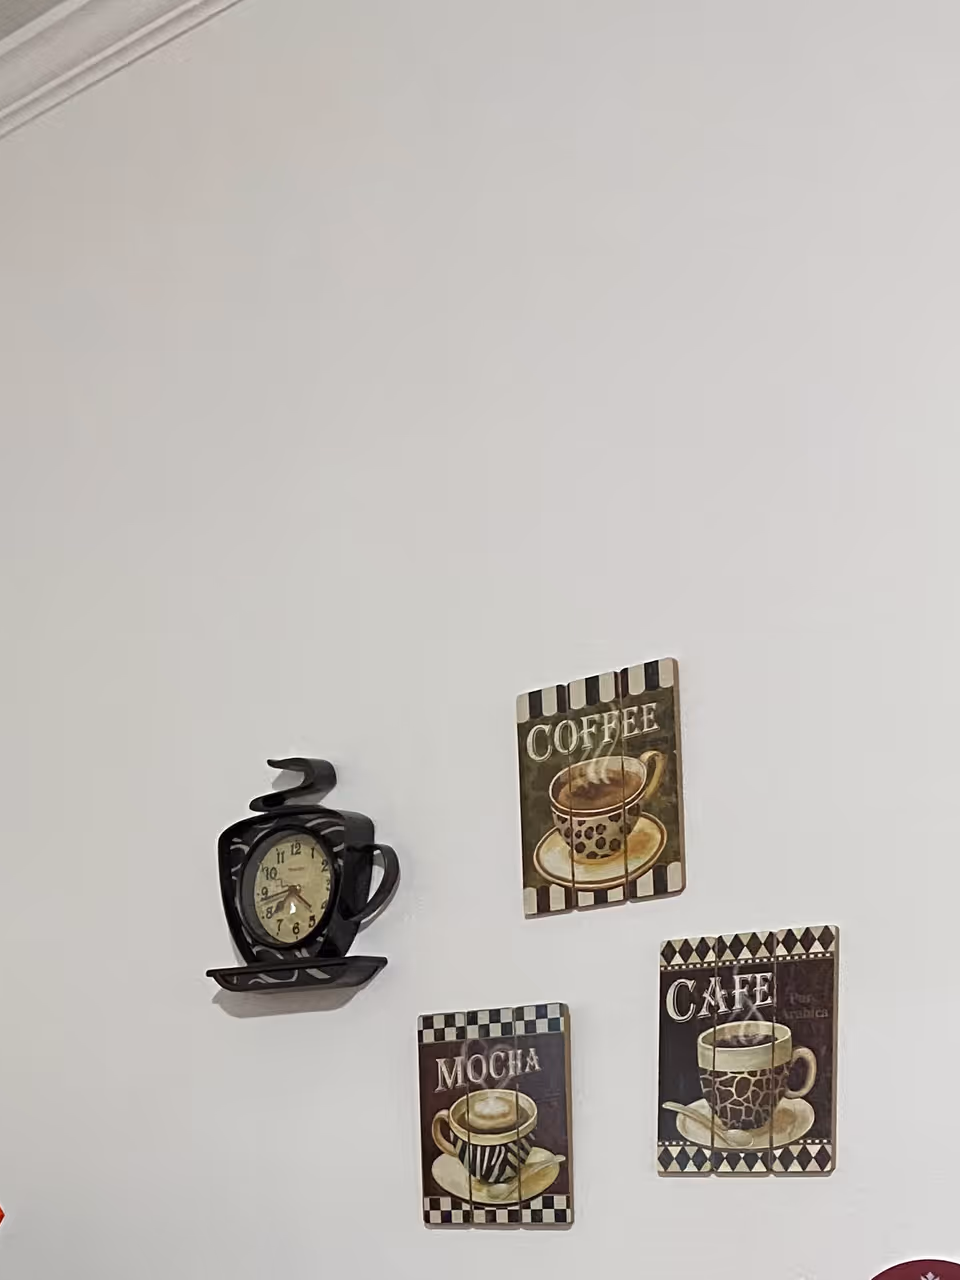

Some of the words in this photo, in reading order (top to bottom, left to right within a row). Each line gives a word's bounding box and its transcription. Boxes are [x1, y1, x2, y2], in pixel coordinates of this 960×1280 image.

[526, 703, 660, 761] COFFEE
[290, 843, 302, 855] 12
[276, 851, 285, 864] 11
[321, 860, 329, 873] 2
[264, 867, 278, 880] 10
[265, 907, 273, 919] 8
[277, 919, 284, 931] 7
[292, 922, 300, 934] 6
[308, 915, 316, 928] 5
[666, 972, 774, 1023] CAFE
[435, 1048, 542, 1093] MOCHA
